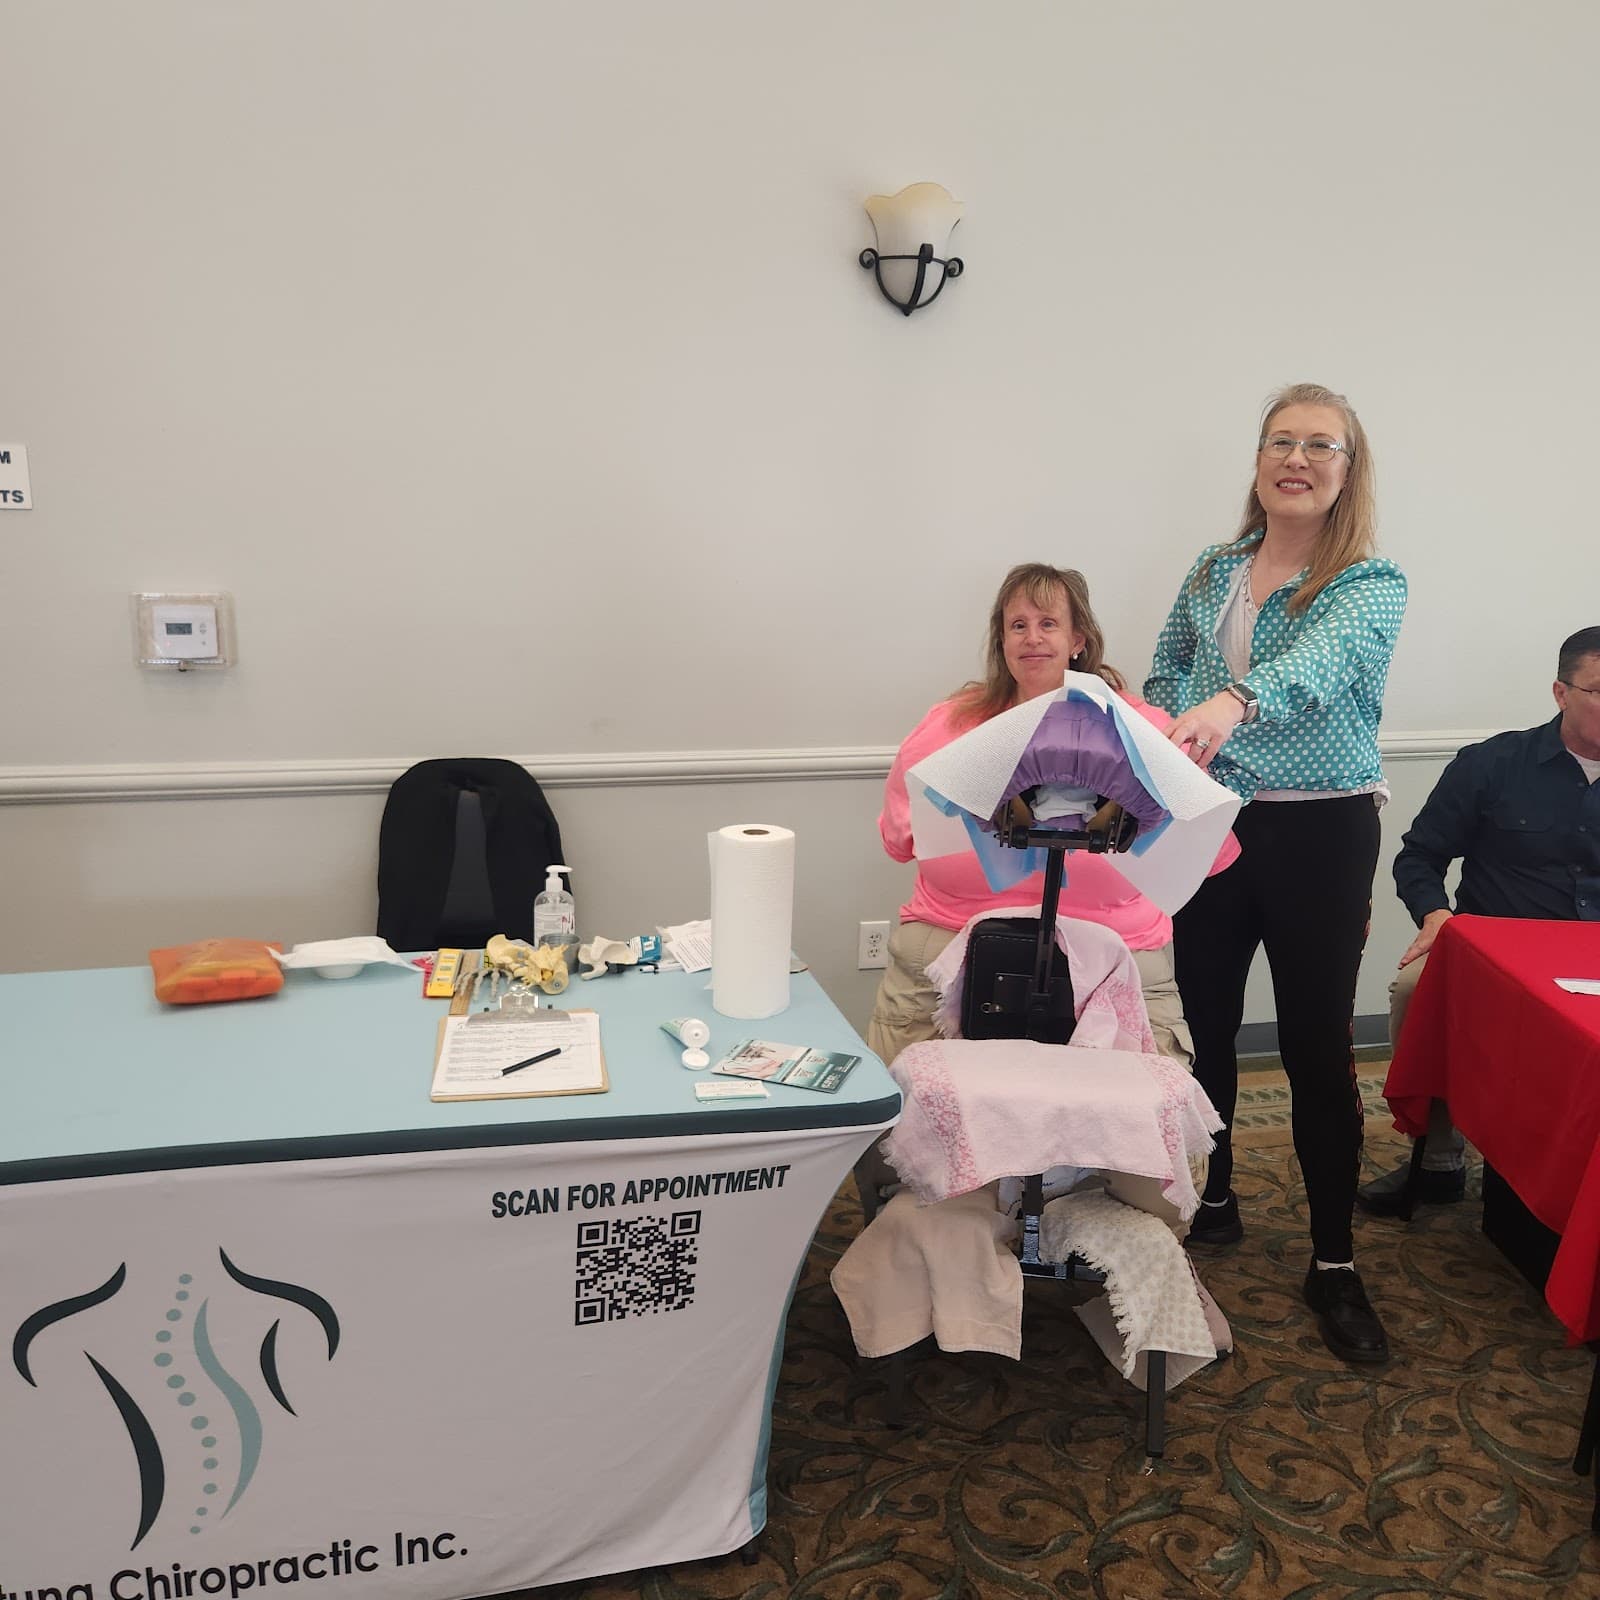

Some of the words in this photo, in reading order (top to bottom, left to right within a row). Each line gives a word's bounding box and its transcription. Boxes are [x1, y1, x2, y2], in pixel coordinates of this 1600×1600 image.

[0, 489, 25, 503] TS
[491, 1187, 559, 1218] SCAN
[567, 1182, 616, 1211] FOR
[621, 1164, 791, 1205] APPOINTMENT
[110, 1539, 379, 1600] Chiropractic
[395, 1532, 468, 1567] Inc.
